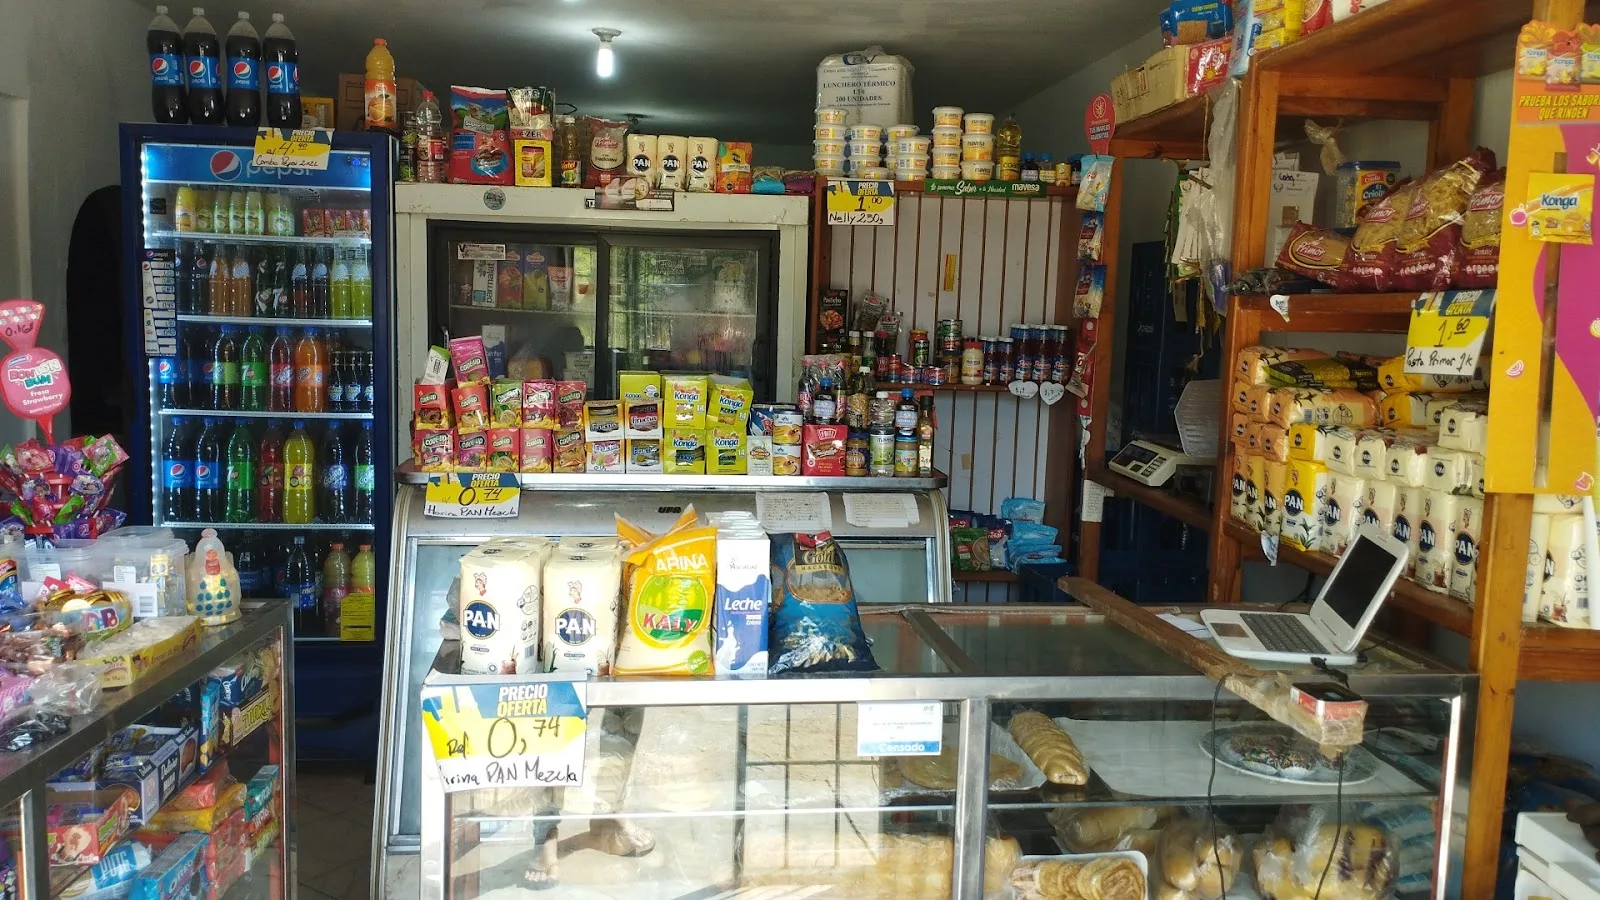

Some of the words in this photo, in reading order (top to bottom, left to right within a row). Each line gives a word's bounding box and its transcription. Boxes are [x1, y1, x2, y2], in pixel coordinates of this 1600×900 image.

[1519, 95, 1551, 107] PRUEBA
[1553, 94, 1569, 106] LOS
[1539, 107, 1555, 120] QUE
[1557, 107, 1589, 119] RINDEN
[632, 158, 651, 168] PAN
[661, 159, 680, 168] PAN
[691, 160, 709, 170] PAN
[857, 188, 878, 196] OFERTA
[858, 181, 879, 190] PRECIO
[955, 180, 977, 195] Sabor
[1011, 183, 1040, 192] mavesa
[1541, 192, 1578, 210] Konga
[828, 212, 856, 225] Nelly
[1297, 241, 1326, 257] Primor
[486, 262, 496, 304] parmalat
[1445, 302, 1475, 316] OFERTA
[1406, 346, 1425, 367] Pasta
[9, 368, 35, 380] BON
[35, 360, 62, 375] BON
[25, 375, 52, 388] BUM
[30, 388, 50, 397] Fresa
[674, 391, 699, 403] Konga
[22, 393, 63, 406] Strawberry
[719, 396, 744, 409] Konga
[632, 415, 657, 424] Fructus
[673, 439, 698, 450] Konga
[714, 438, 740, 449] Konga
[471, 473, 501, 481] PRECIO
[1247, 485, 1258, 500] AN
[1284, 494, 1304, 511] PAN
[460, 508, 482, 517] PAN
[484, 505, 517, 517] Mezcla
[1455, 539, 1475, 560] PAN
[655, 552, 709, 573] ARINA
[803, 549, 836, 564] Gold
[724, 597, 762, 611] Leche
[499, 683, 549, 701] PRECIO
[497, 699, 547, 718] OFERTA
[487, 715, 561, 759] 0,74
[877, 742, 926, 753] Censado
[485, 760, 518, 784] PAN
[524, 756, 578, 783] Mezcla
